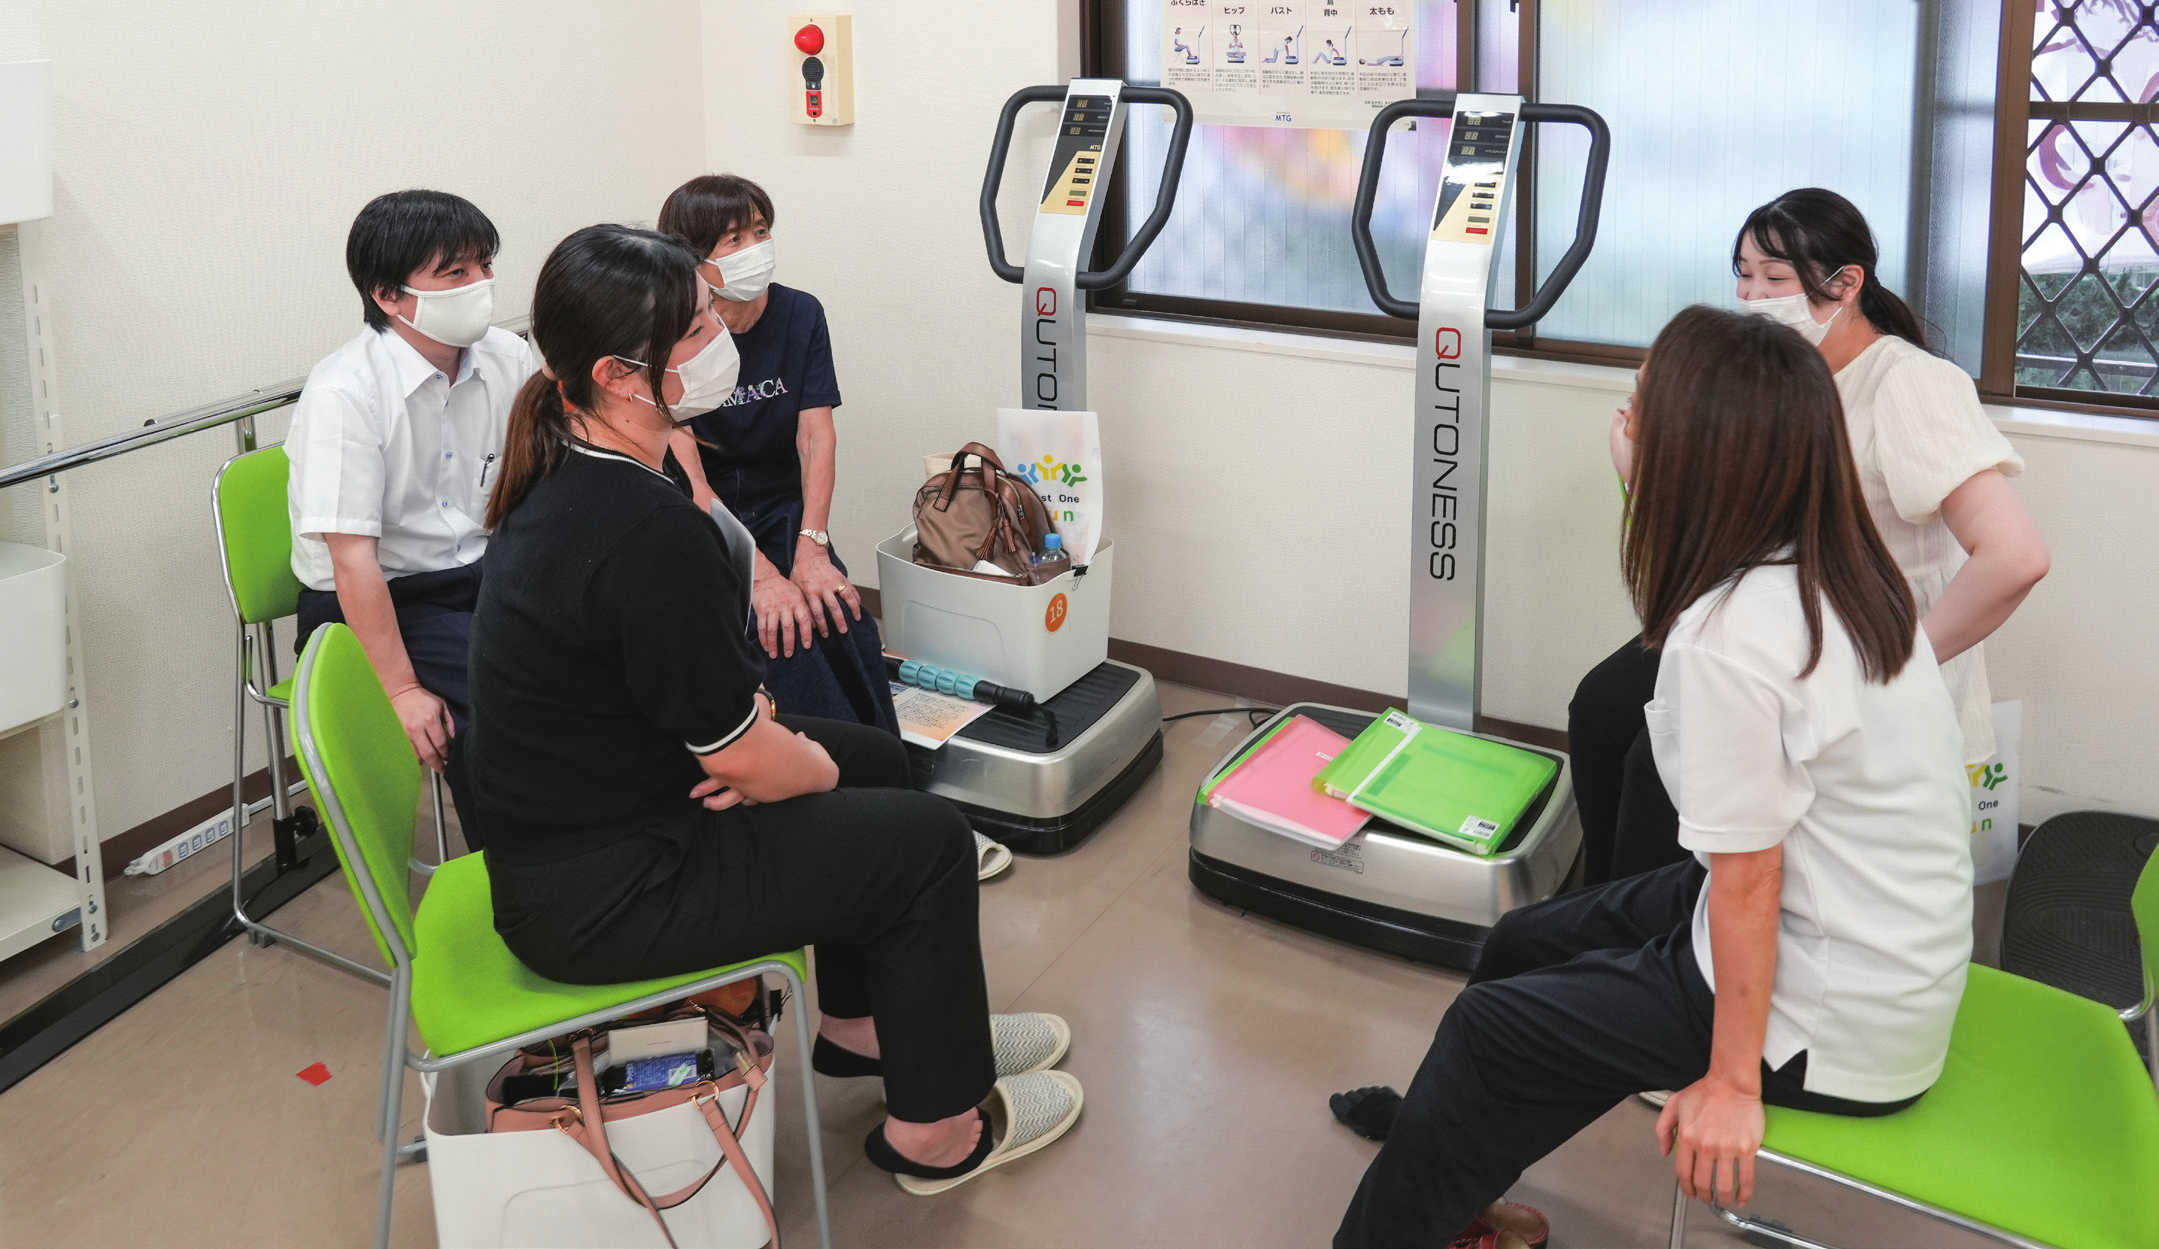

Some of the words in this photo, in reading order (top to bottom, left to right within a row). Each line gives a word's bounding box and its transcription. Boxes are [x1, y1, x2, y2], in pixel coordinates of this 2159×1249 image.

[1224, 6, 1246, 15] ヒップ
[1270, 6, 1293, 15] バスト
[1369, 6, 1395, 16] 太もも
[1429, 326, 1462, 581] QUTONESS
[1058, 494, 1080, 503] One
[1050, 599, 1064, 623] 18
[1978, 799, 1999, 811] One
